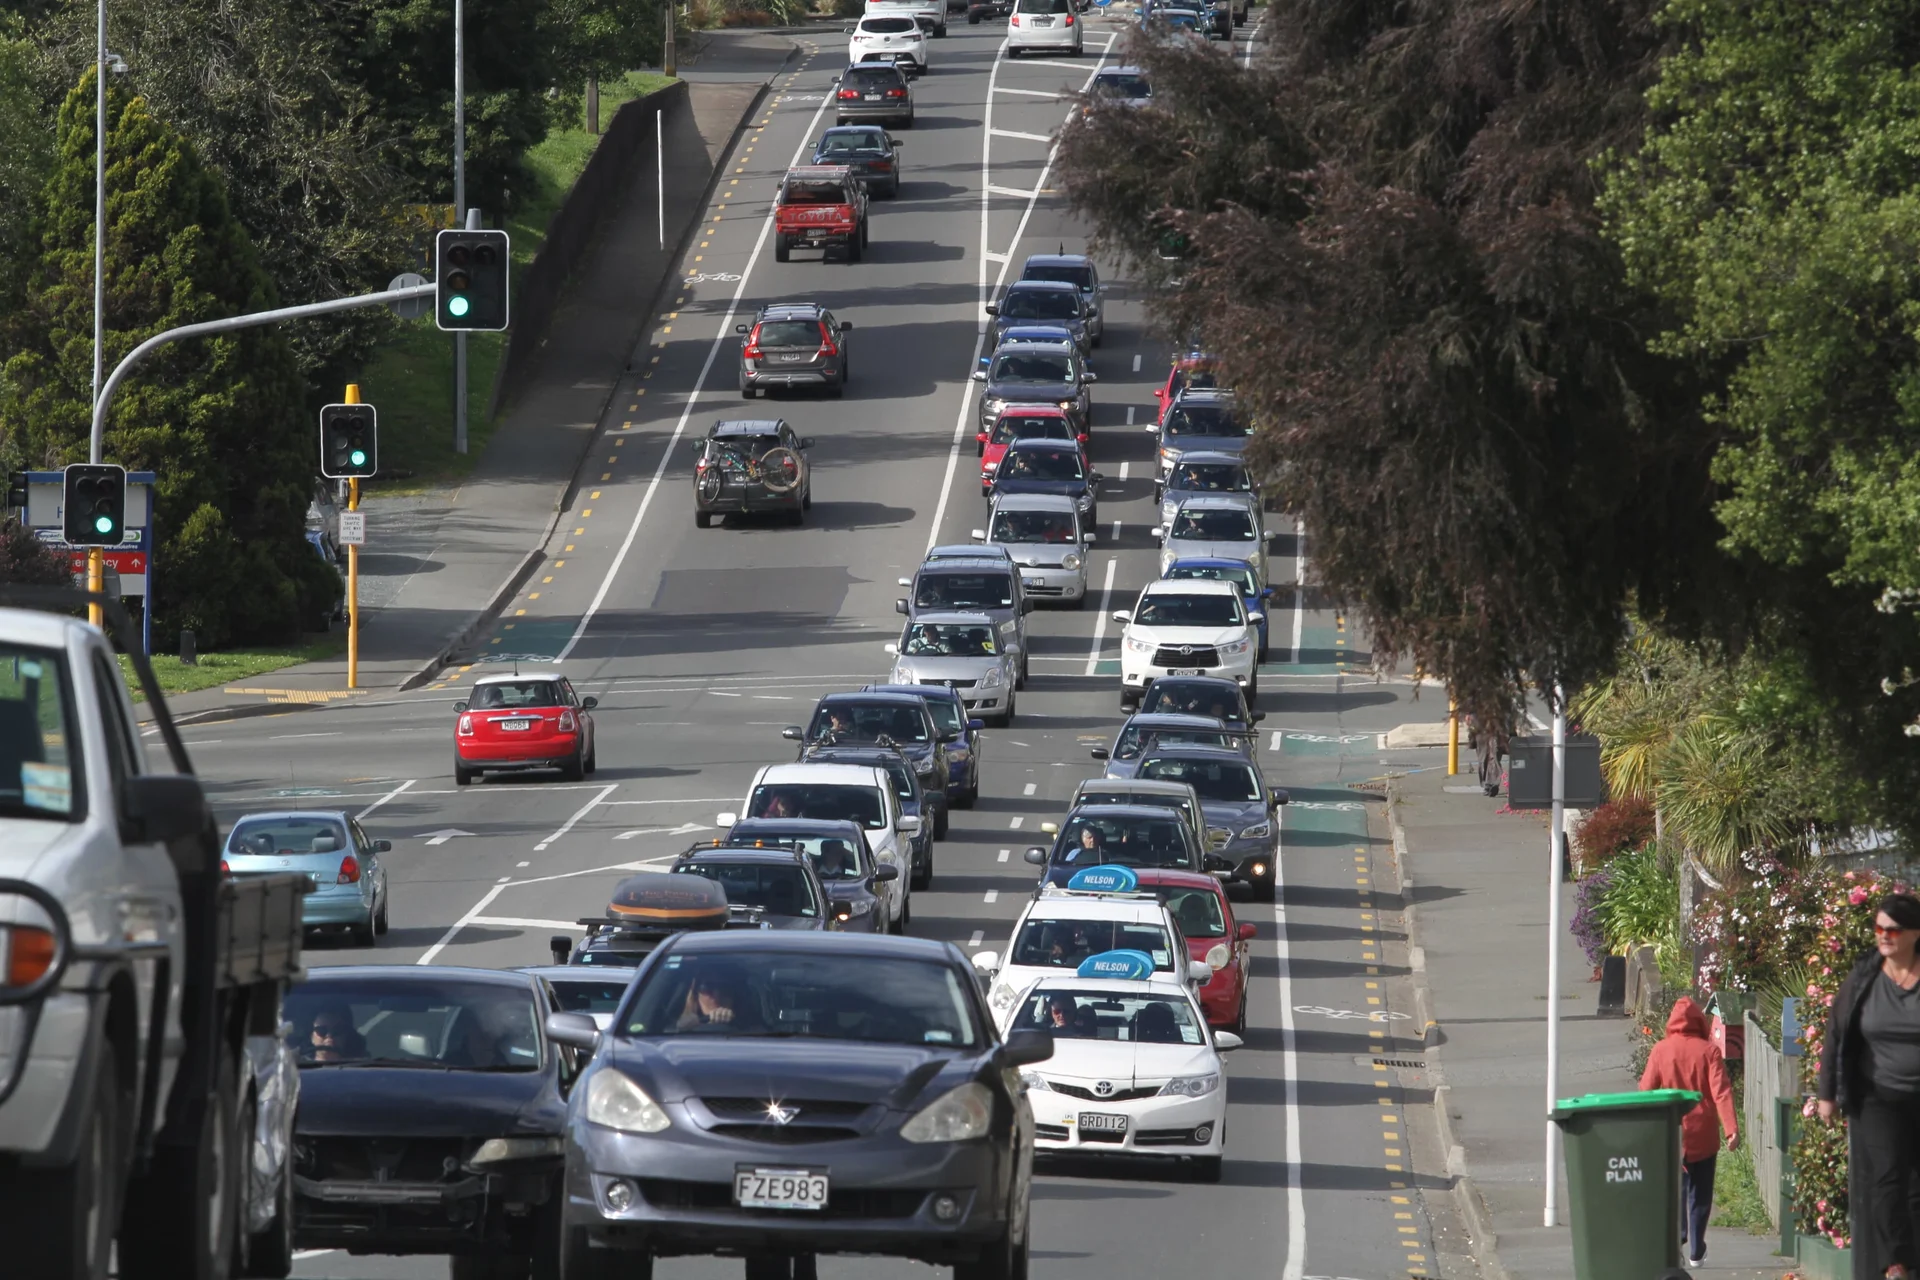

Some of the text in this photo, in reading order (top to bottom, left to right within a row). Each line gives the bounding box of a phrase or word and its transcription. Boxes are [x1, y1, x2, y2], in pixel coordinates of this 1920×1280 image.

[789, 212, 842, 221] TOYOTA
[1084, 875, 1115, 885] NELSON
[1094, 962, 1130, 972] NELSON
[1080, 1115, 1126, 1129] GRD112
[1608, 1157, 1638, 1169] CAN
[1606, 1169, 1643, 1182] PLAN
[739, 1176, 825, 1201] FZE983
